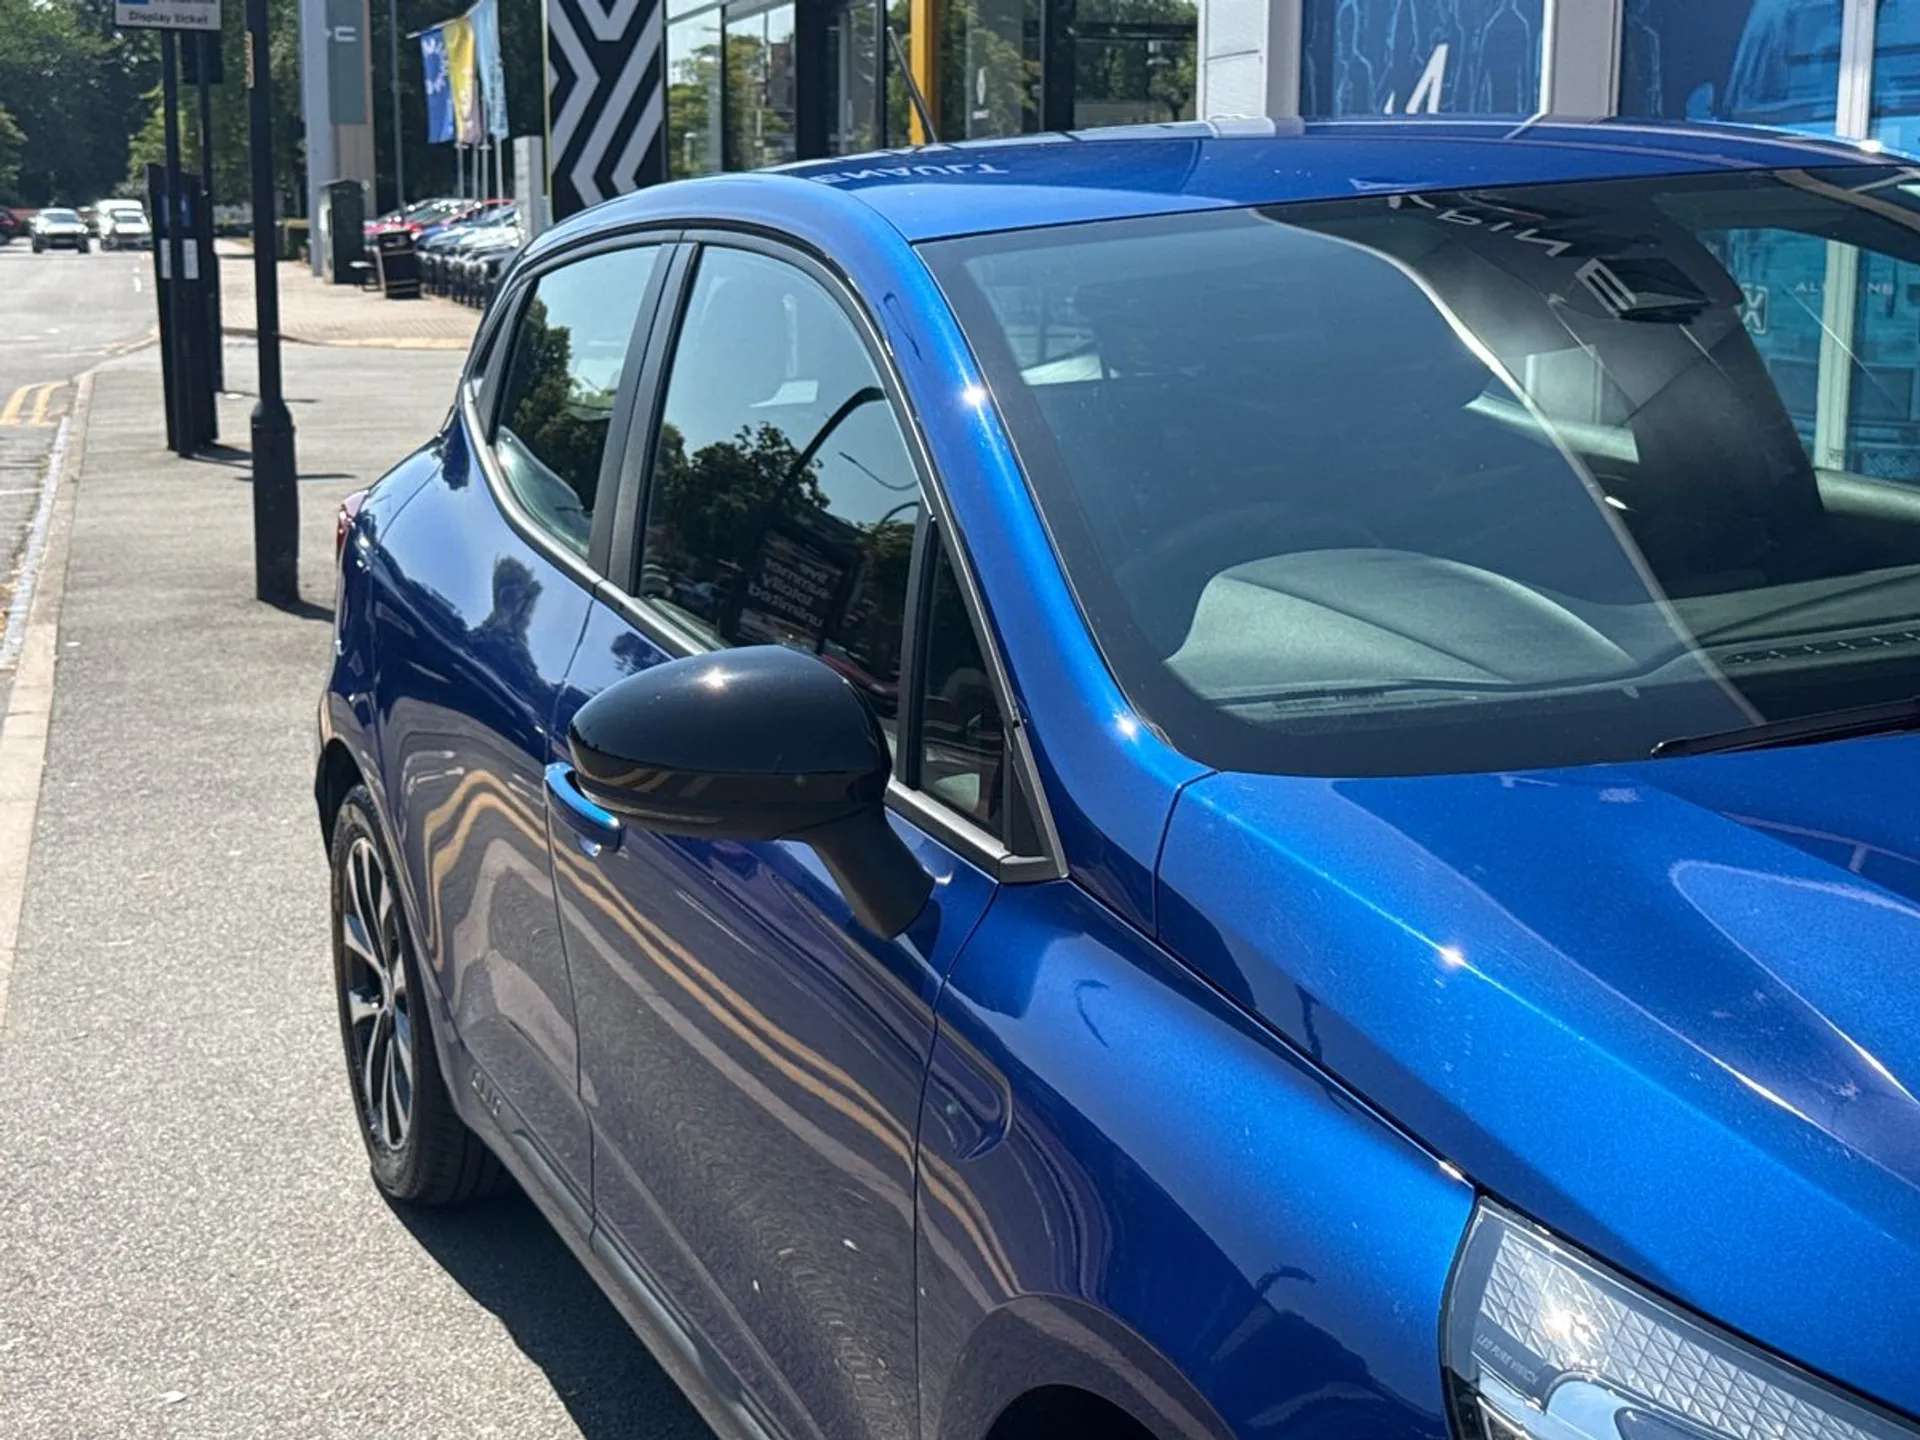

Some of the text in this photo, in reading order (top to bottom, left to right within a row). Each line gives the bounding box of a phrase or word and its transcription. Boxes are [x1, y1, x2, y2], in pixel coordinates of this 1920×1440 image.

[128, 10, 209, 25] Display ticket
[1794, 281, 1893, 295] ALNE
